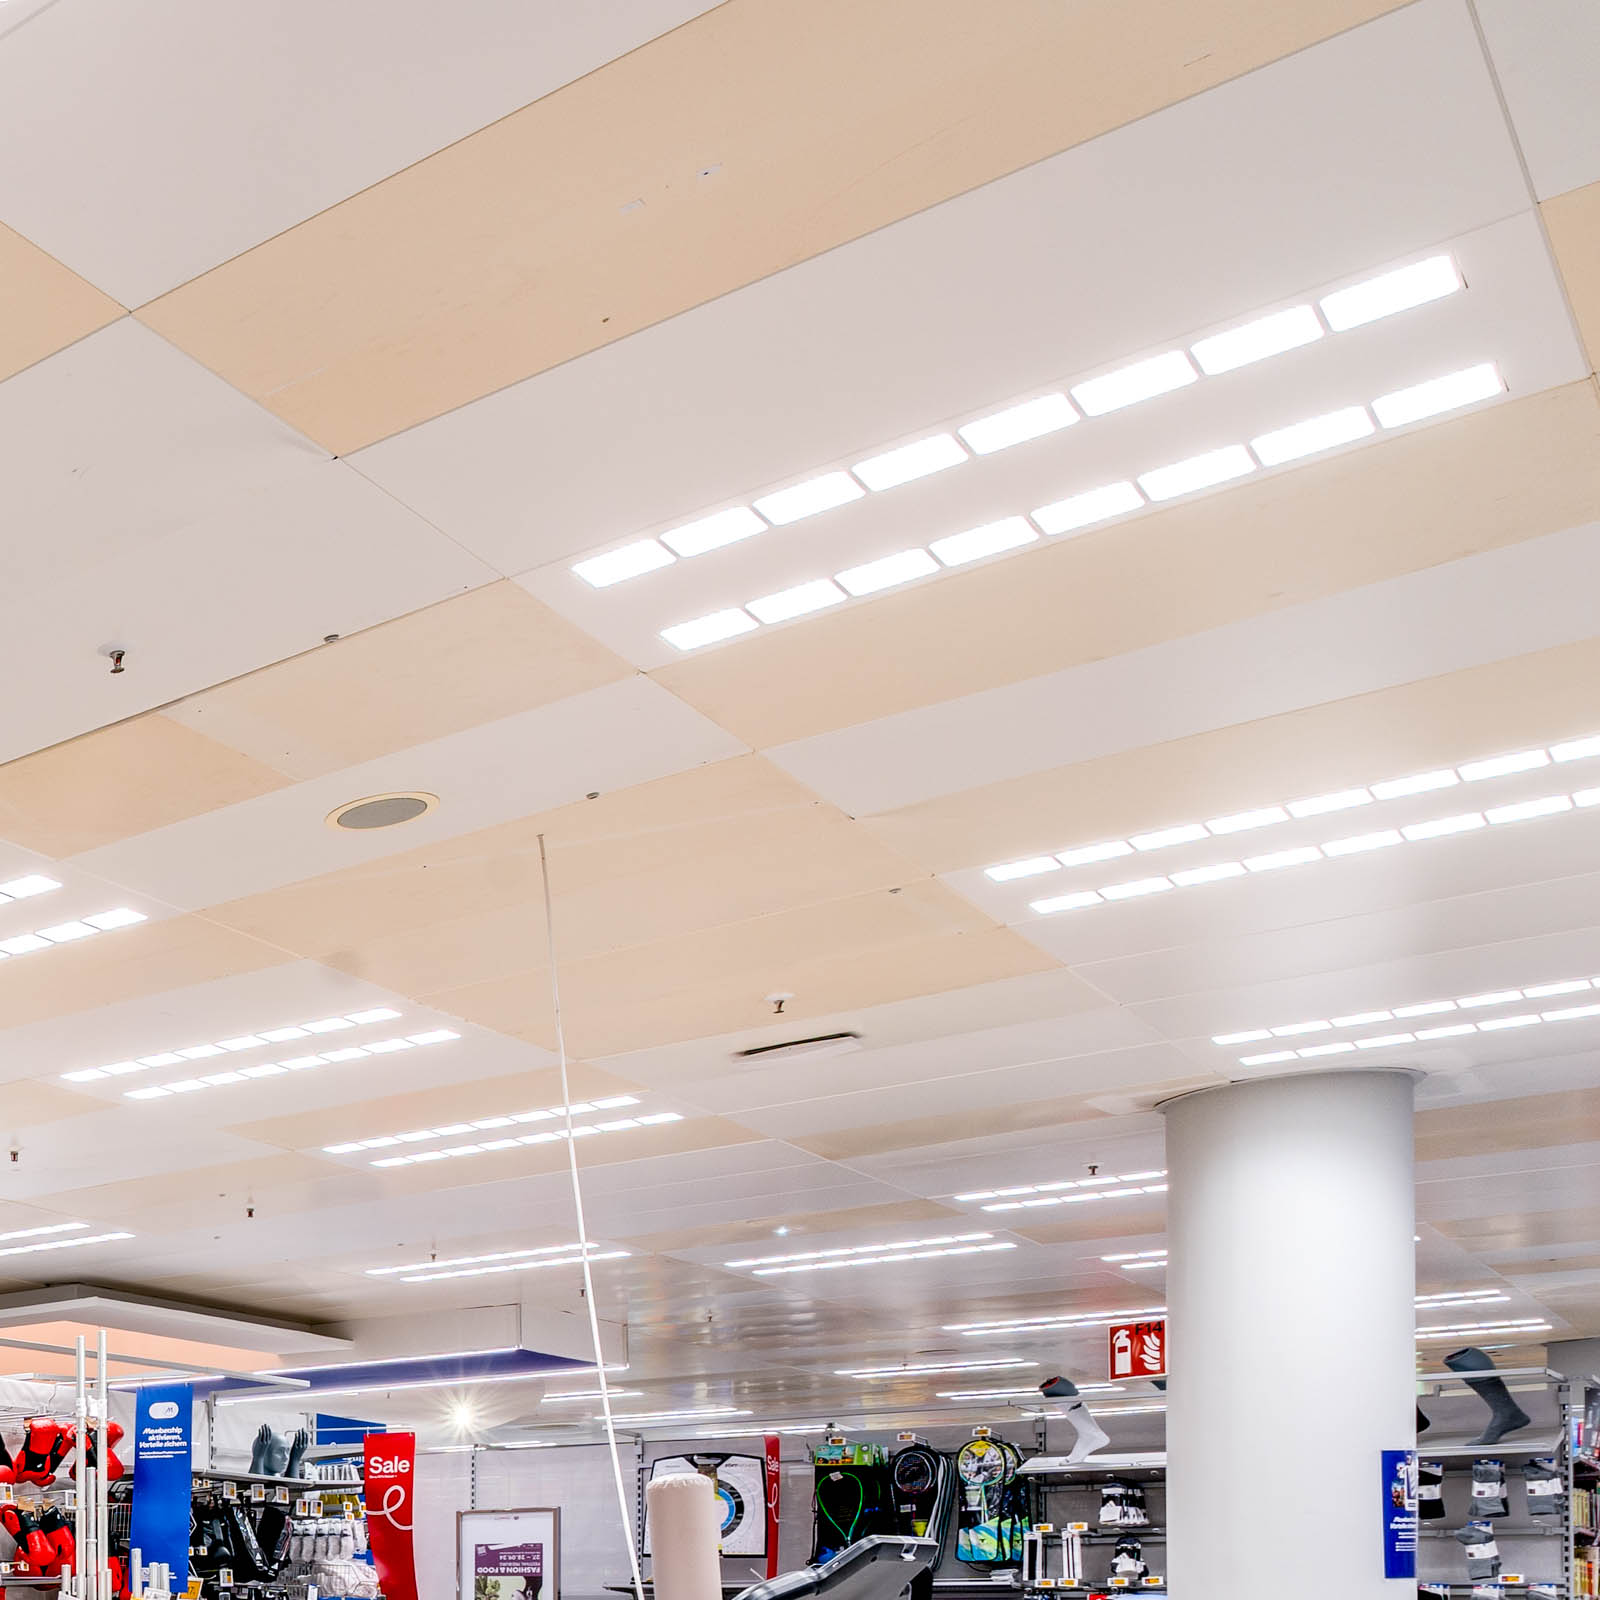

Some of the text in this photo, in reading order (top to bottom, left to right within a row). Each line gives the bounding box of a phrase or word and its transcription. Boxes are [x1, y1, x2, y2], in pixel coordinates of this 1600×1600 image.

[1135, 1321, 1163, 1335] F14
[142, 1426, 183, 1436] Membership
[368, 1455, 410, 1474] Sale
[506, 1566, 541, 1574] FASHION
